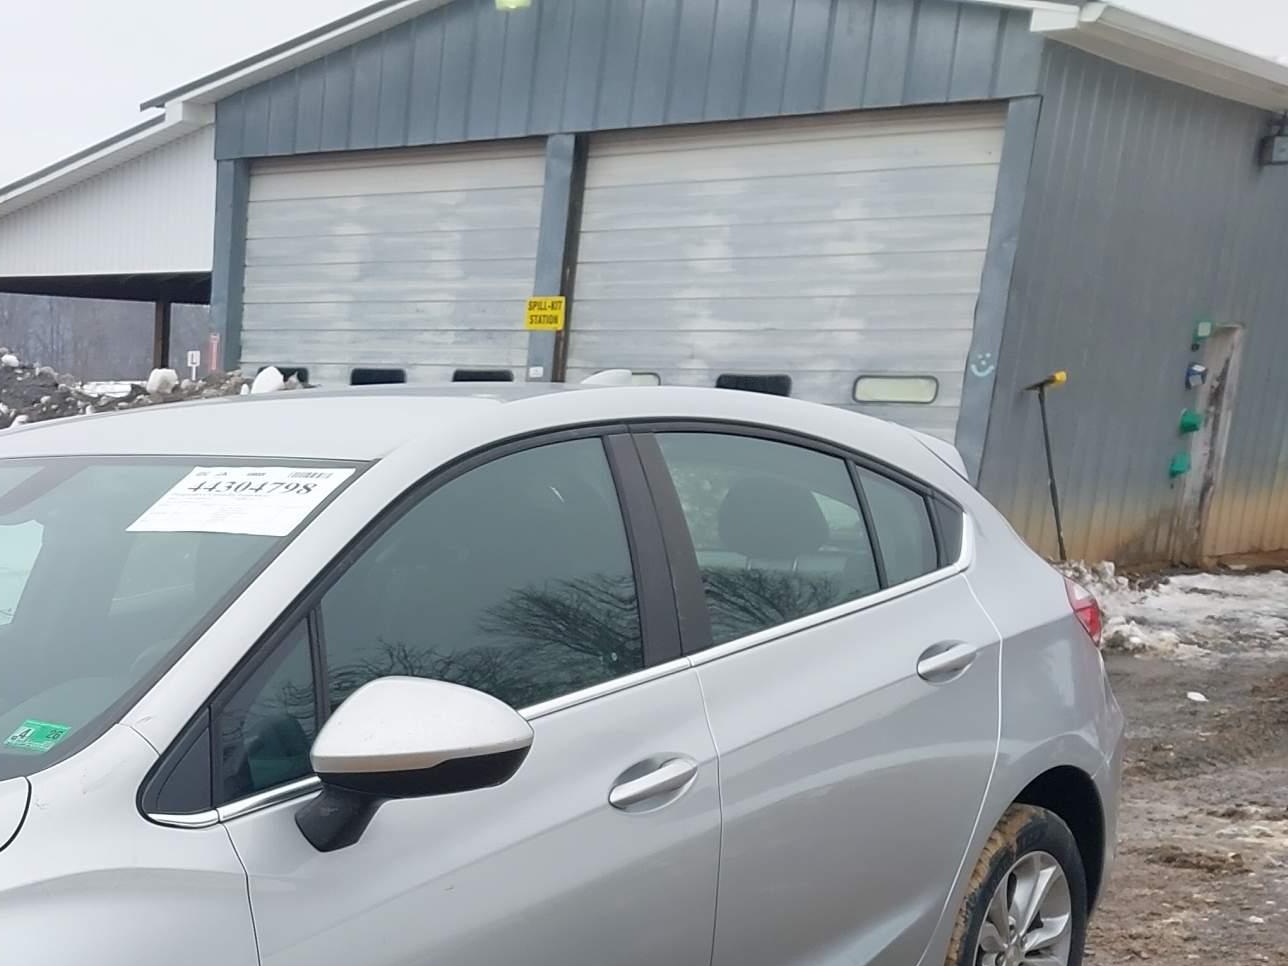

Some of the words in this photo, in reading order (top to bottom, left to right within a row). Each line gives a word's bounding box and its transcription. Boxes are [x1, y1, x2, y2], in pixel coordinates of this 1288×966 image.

[527, 301, 563, 311] SPILL-KIT
[529, 315, 558, 325] STATION
[186, 480, 319, 495] 44304798
